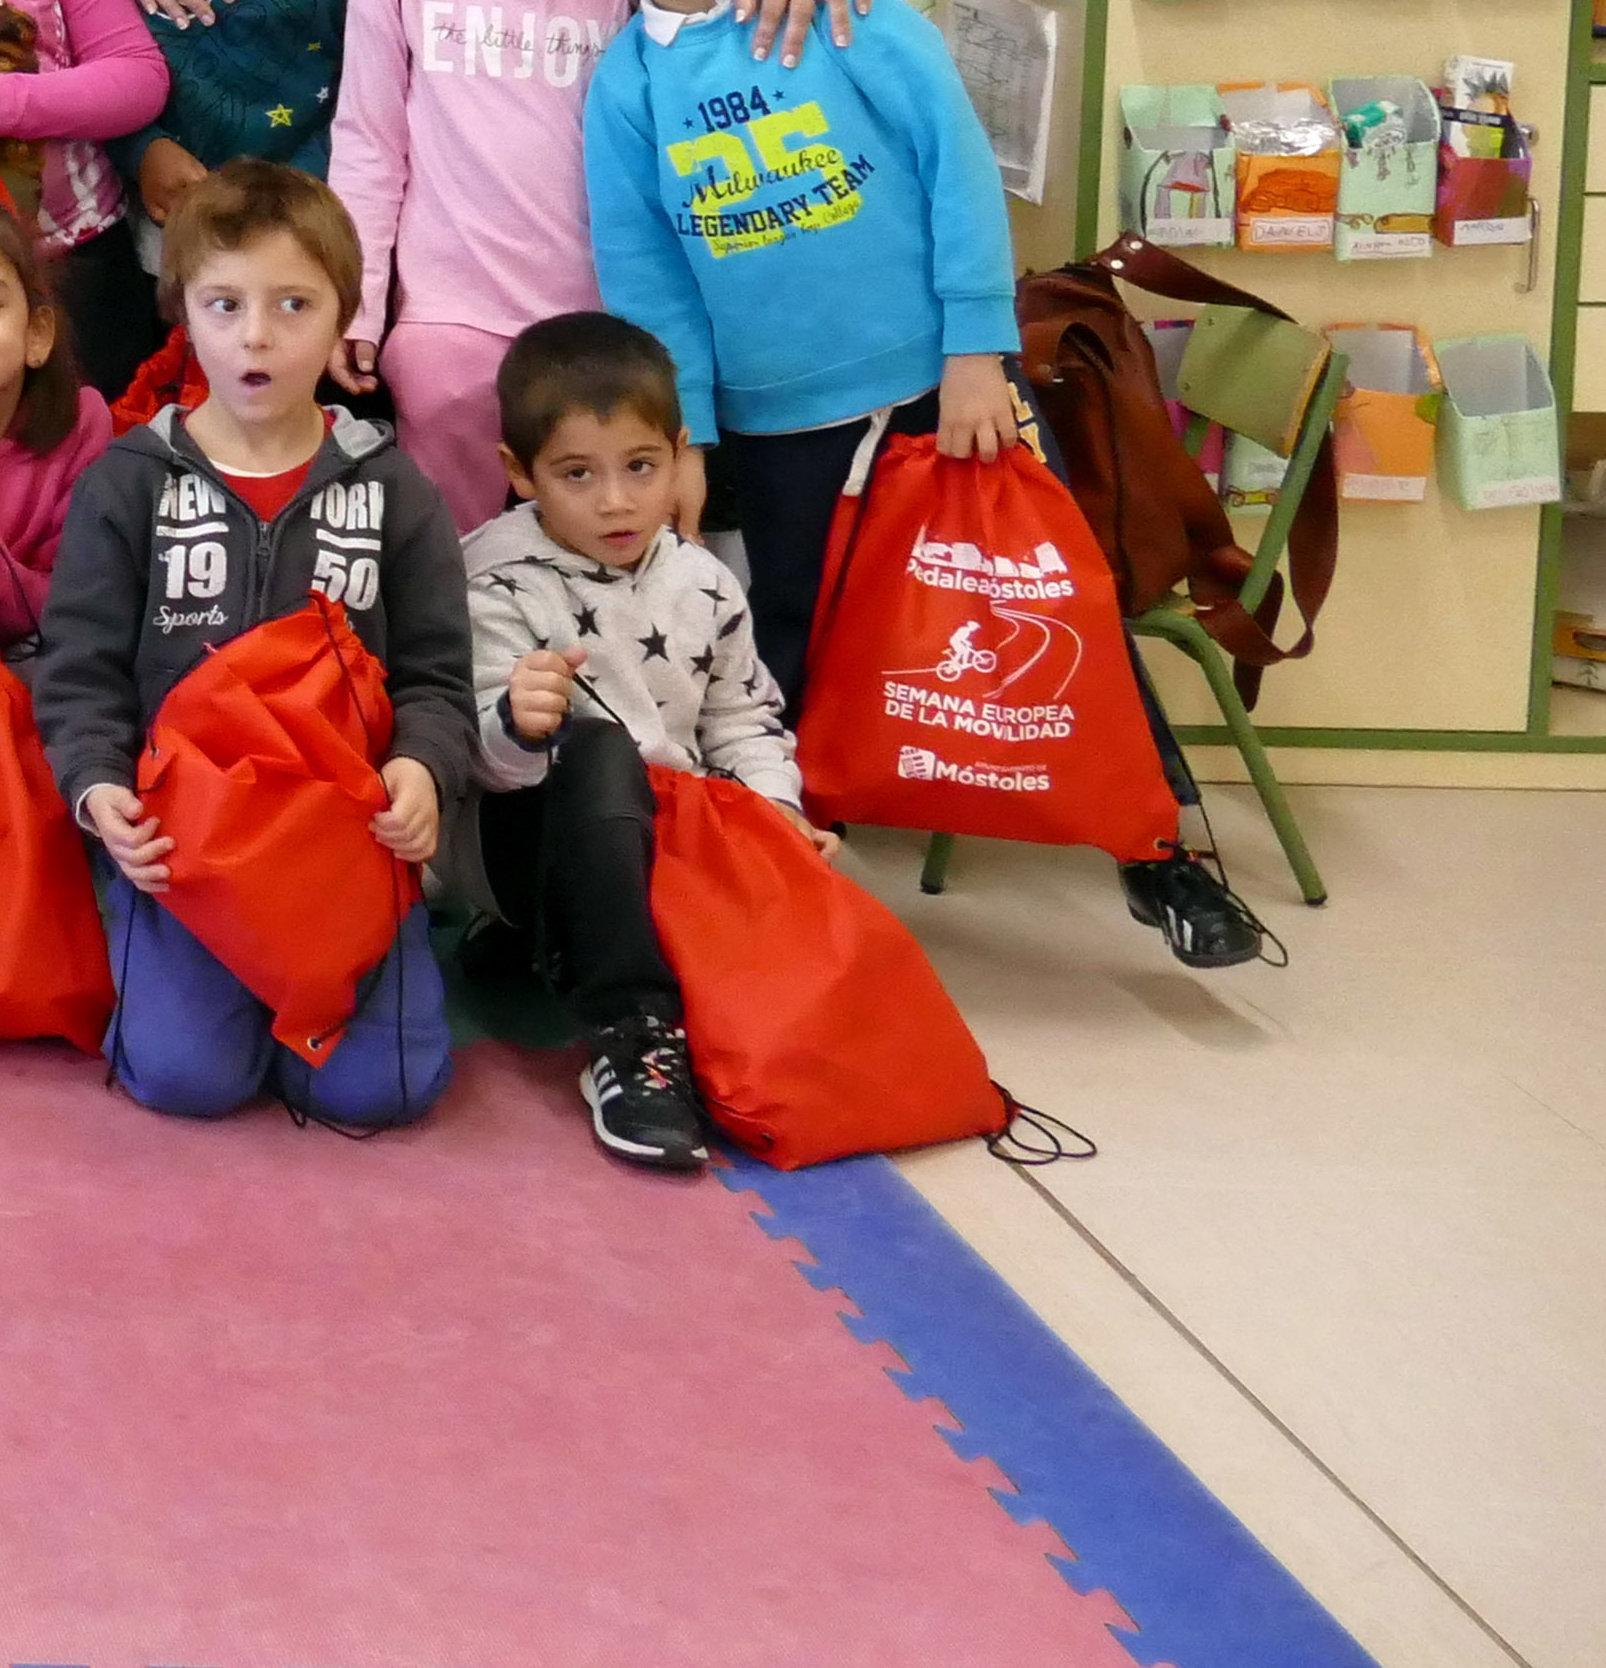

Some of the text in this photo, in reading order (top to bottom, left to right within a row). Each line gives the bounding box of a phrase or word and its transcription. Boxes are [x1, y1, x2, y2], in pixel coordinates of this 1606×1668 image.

[431, 24, 467, 45] the
[480, 23, 533, 52] little
[697, 85, 772, 134] 1984
[666, 100, 863, 259] 25
[676, 153, 876, 238] LEGENDARY TEAM
[681, 148, 839, 209] Milwaukee
[157, 472, 227, 521] NEW
[158, 541, 380, 611] 19 50
[152, 603, 228, 634] Sports
[883, 681, 1075, 724] SEMANA EUROPEA
[884, 700, 1070, 743] DE LA MOVILIDAD
[935, 760, 1050, 792] Móstoles
